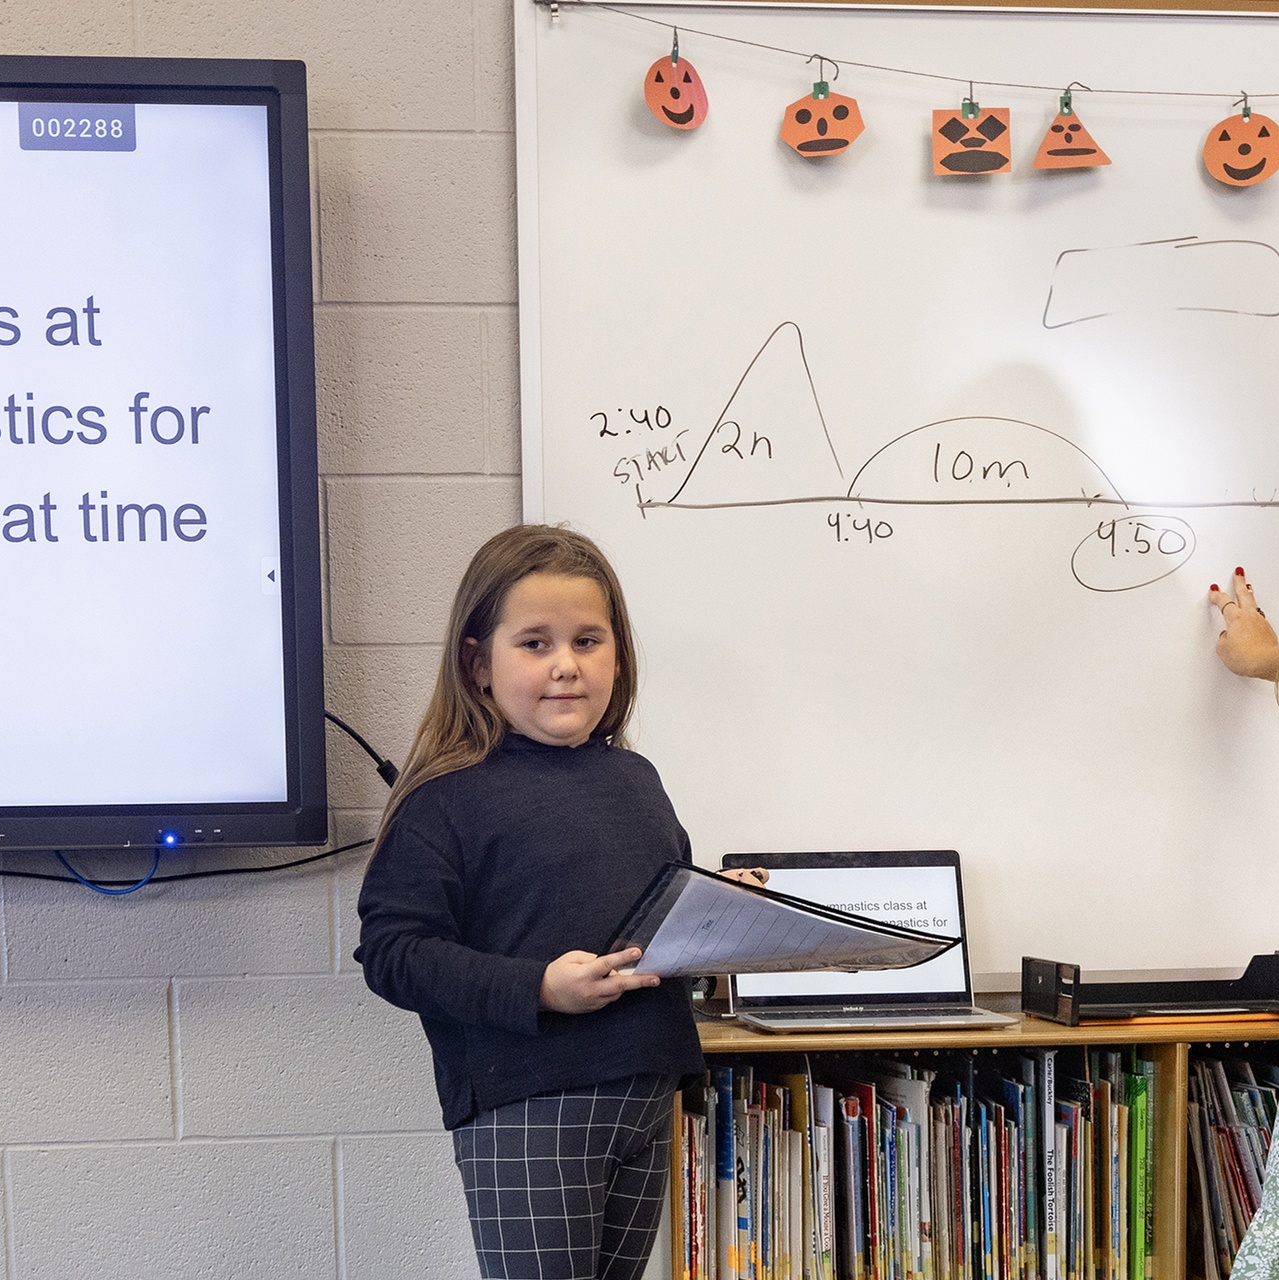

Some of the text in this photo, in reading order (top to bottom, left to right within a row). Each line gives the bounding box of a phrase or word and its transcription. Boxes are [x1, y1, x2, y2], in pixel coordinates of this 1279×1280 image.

[31, 117, 124, 139] 002288
[44, 294, 102, 347] at
[129, 391, 211, 445] for
[590, 405, 672, 438] 2:40
[613, 429, 690, 484] START
[79, 489, 208, 543] time
[827, 512, 893, 543] 4:40
[1097, 519, 1187, 557] 4:50
[883, 900, 913, 911] class
[916, 900, 927, 911] at
[932, 916, 948, 928] for
[1047, 1167, 1055, 1193] Foolish
[1047, 1195, 1055, 1232] Tortoise
